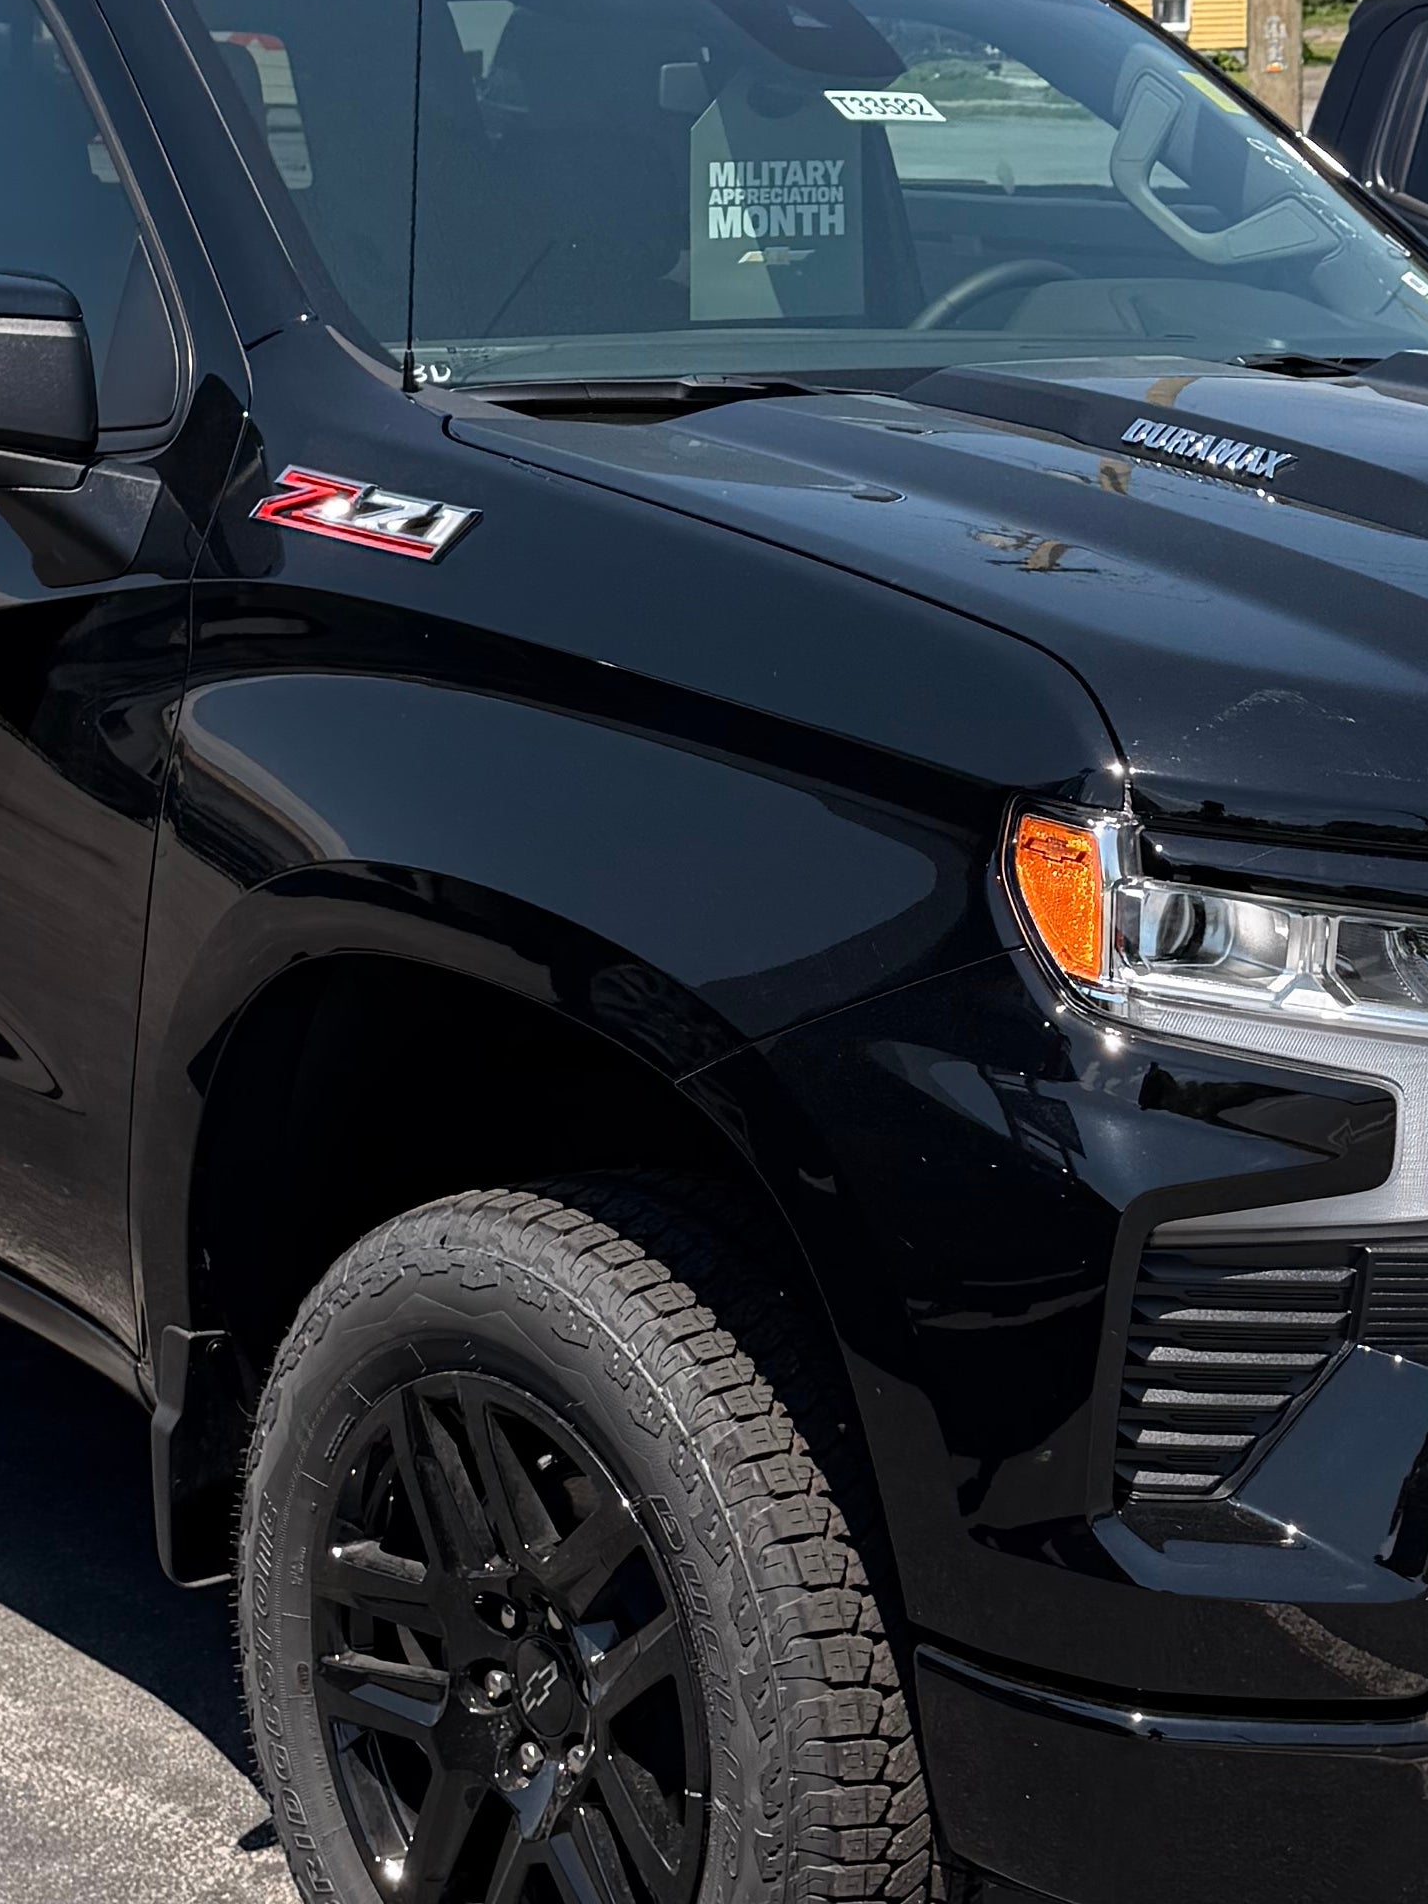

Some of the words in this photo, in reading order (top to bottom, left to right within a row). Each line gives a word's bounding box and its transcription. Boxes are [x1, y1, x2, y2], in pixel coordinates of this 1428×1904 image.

[830, 96, 933, 116] T33582
[708, 160, 845, 188] MILITARY
[708, 186, 844, 206] APPRECIATION
[708, 204, 845, 239] MONTH
[1121, 417, 1299, 480] DURAMAX
[248, 464, 484, 566] Z71
